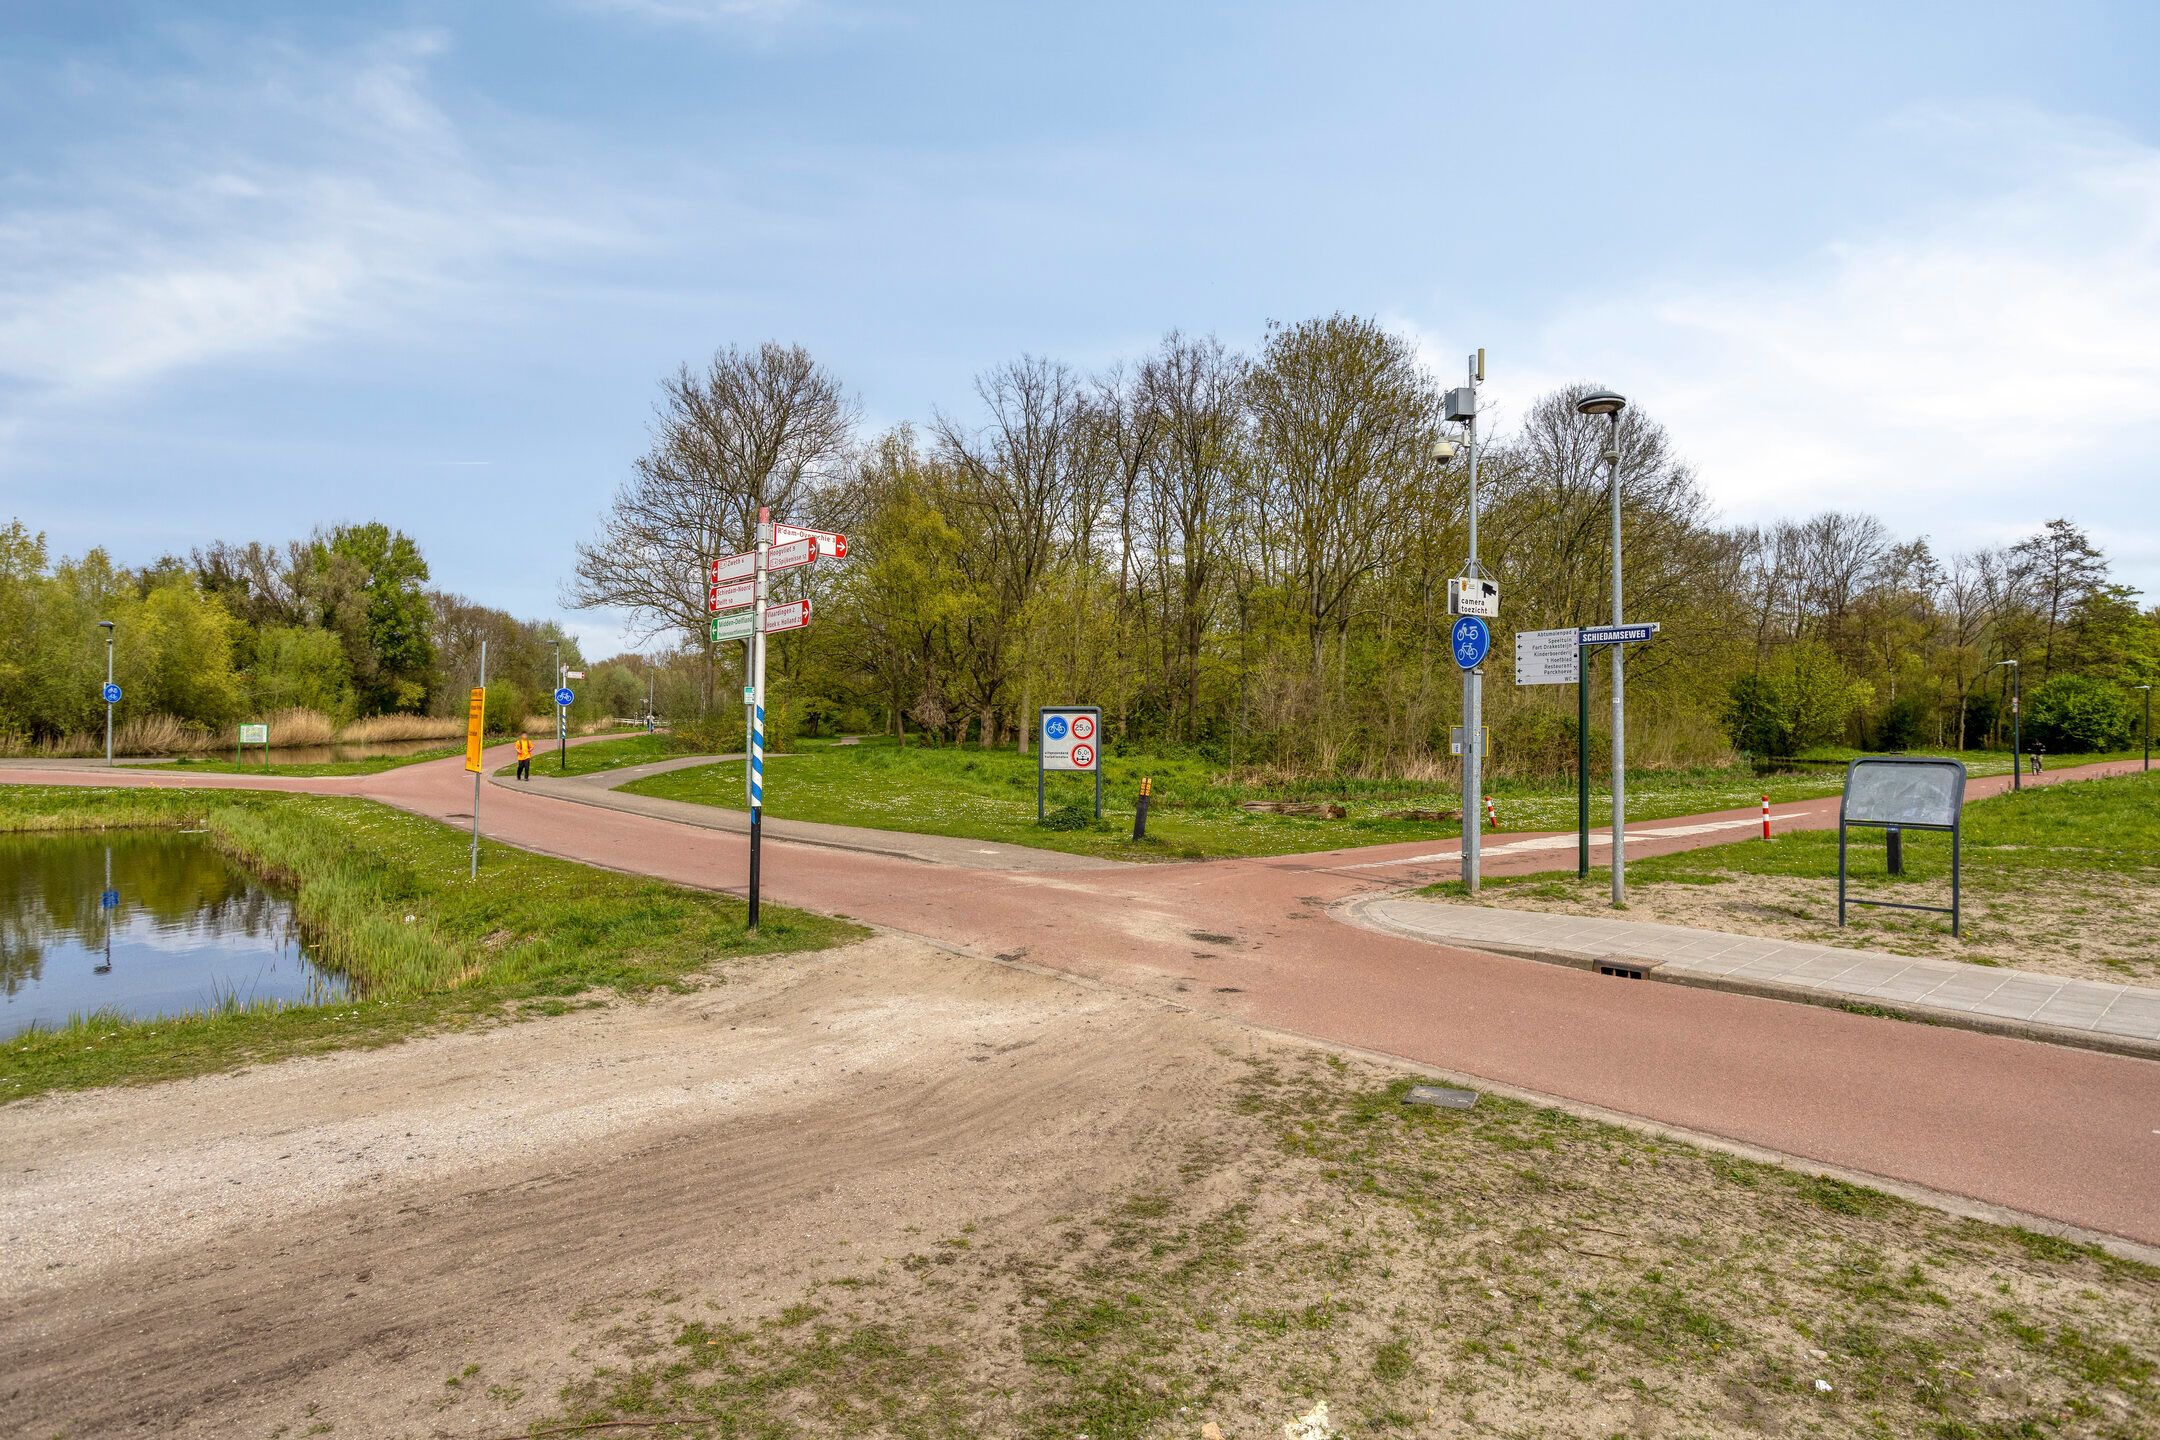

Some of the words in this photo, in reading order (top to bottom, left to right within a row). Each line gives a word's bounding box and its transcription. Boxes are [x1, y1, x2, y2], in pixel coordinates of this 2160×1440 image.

[778, 527, 831, 541] R'dam-Overchie
[1461, 598, 1485, 606] camera
[767, 608, 792, 618] Vlaardingen
[1461, 605, 1488, 614] toezicht
[1582, 629, 1646, 642] SCHIEDAMSEWEG
